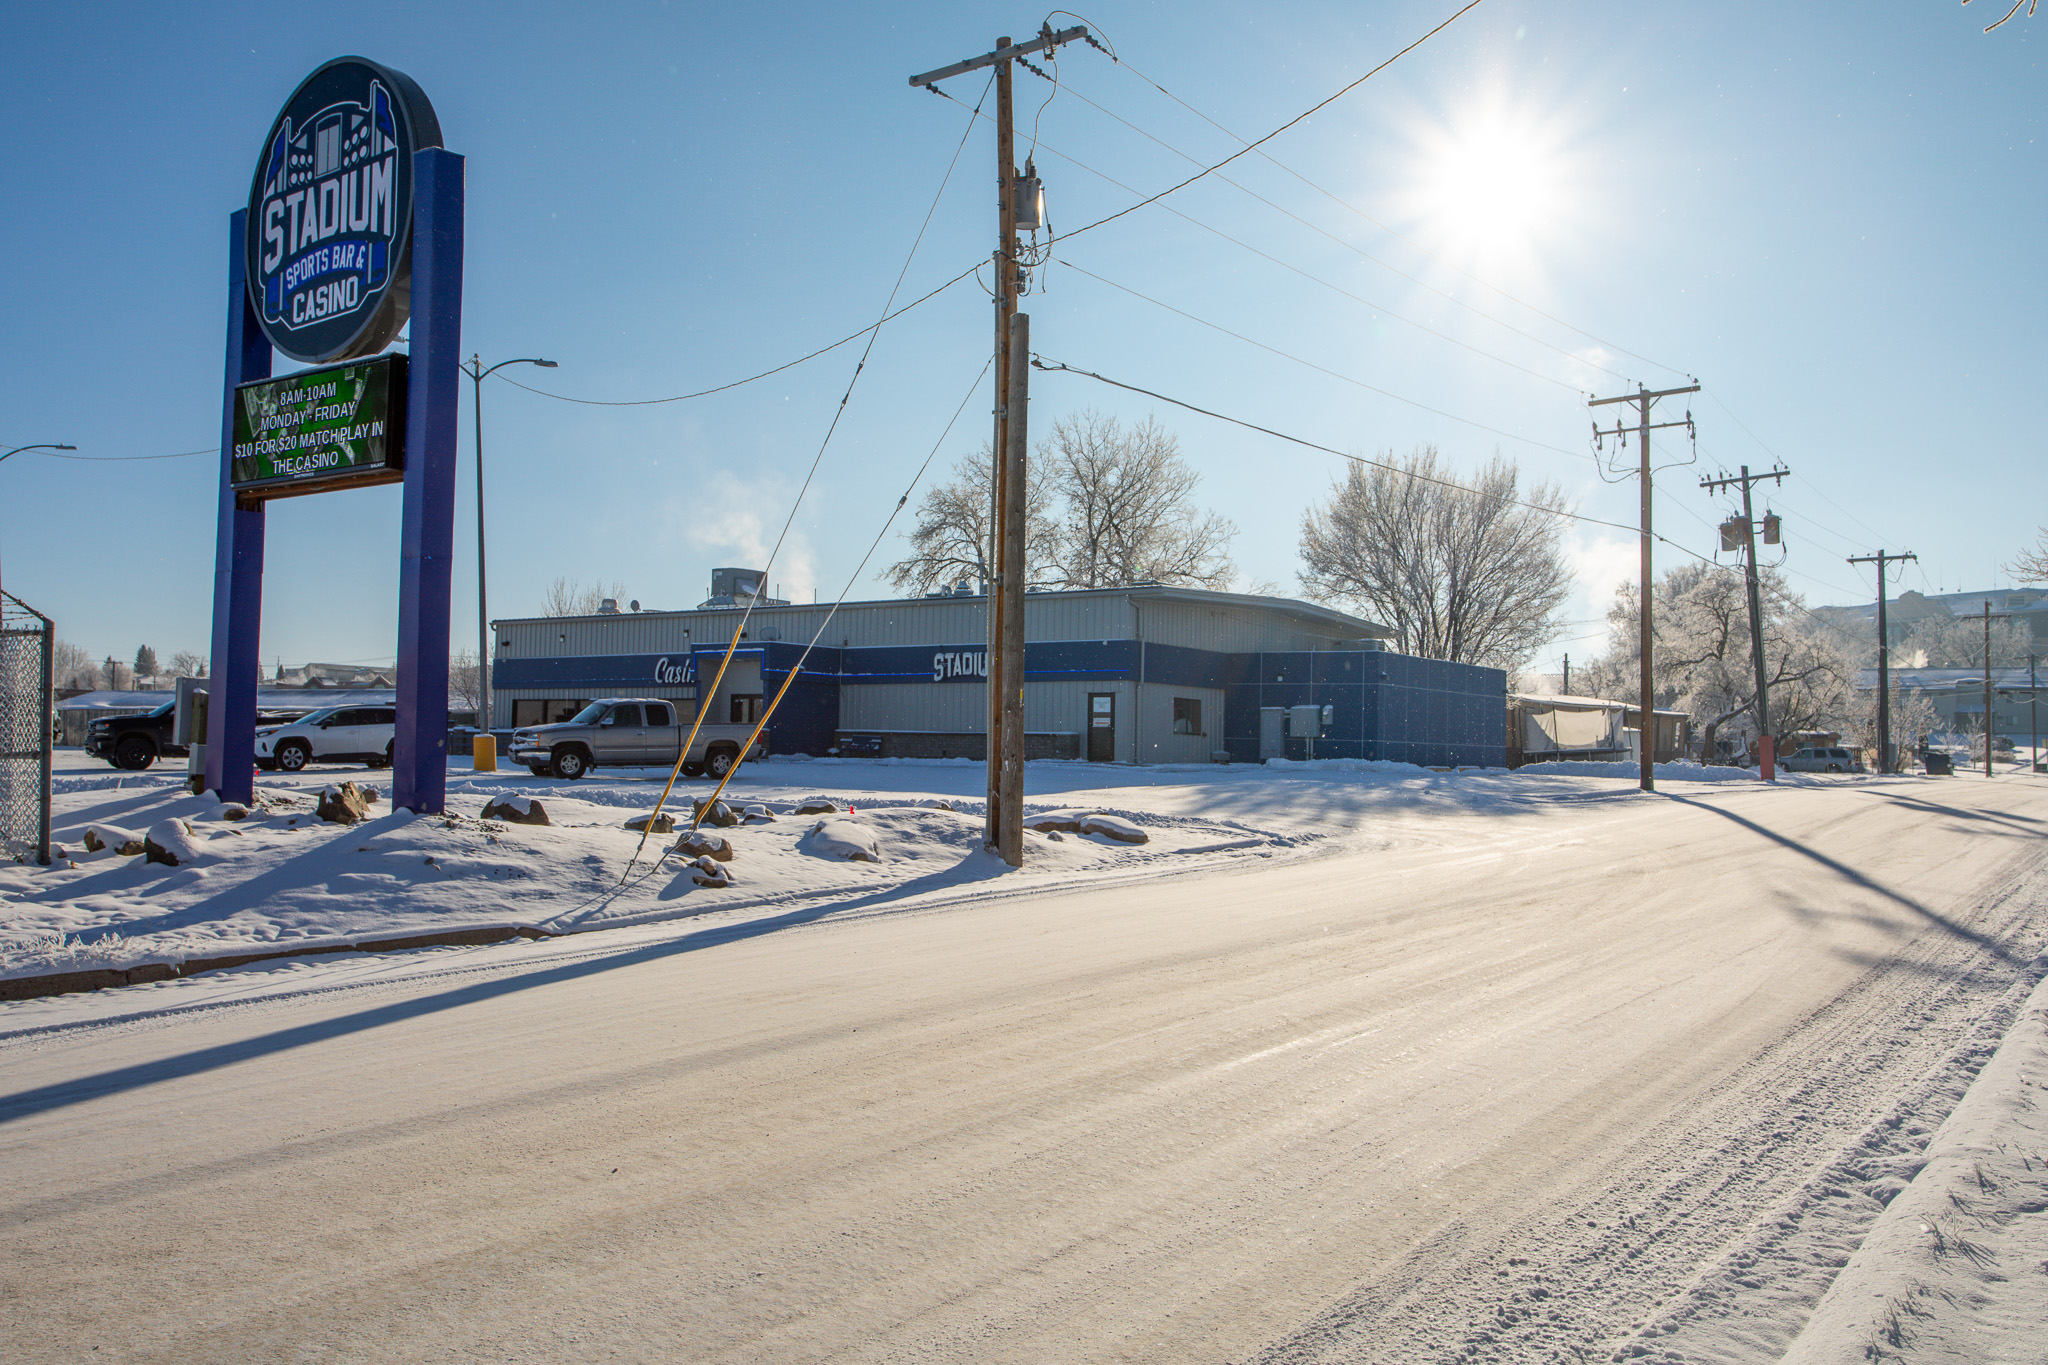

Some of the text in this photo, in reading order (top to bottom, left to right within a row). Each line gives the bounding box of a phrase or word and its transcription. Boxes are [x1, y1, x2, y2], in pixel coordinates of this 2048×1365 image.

[264, 155, 393, 274] STADIUM
[286, 244, 366, 290] SPORTS BAR &
[293, 275, 359, 324] CASINO
[260, 409, 307, 432] MONDAY
[315, 401, 356, 422] FRIDAY
[235, 420, 384, 459] $10 FOR $20 MATCH PLAY IN
[273, 451, 339, 475] THE CASINO
[933, 652, 994, 682] STADIU
